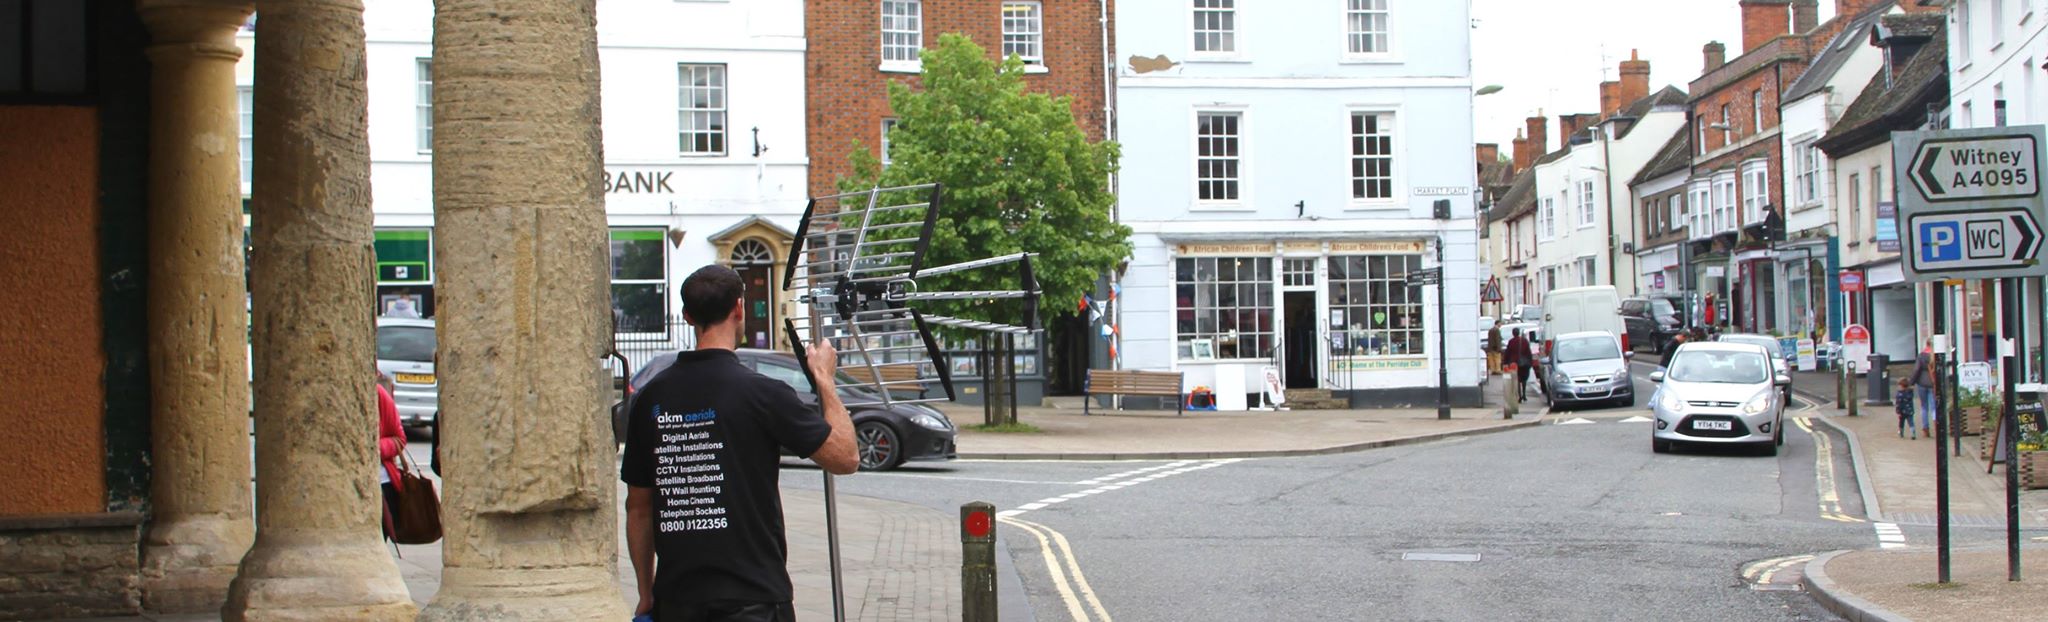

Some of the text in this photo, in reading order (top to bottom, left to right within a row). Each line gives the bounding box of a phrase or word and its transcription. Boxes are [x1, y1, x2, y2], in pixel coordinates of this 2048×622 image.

[1950, 149, 2022, 166] Witney
[1952, 168, 2028, 188] A4095
[1332, 243, 1357, 251] African
[1930, 226, 2001, 258] P WC
[1194, 245, 1220, 253] African
[1255, 244, 1272, 253] Fund
[657, 408, 716, 424] akm aerials
[662, 431, 710, 443] Digital Aerials
[654, 442, 724, 455] atellite Installations
[659, 452, 716, 465] Sky Installations
[656, 464, 721, 475] CCTV Installations
[656, 473, 725, 486] Satellite Broadband
[660, 484, 721, 496] TV Wall Mounting
[667, 496, 715, 506] Home Cinema
[695, 506, 726, 516] Sockets
[660, 520, 685, 532] 0800
